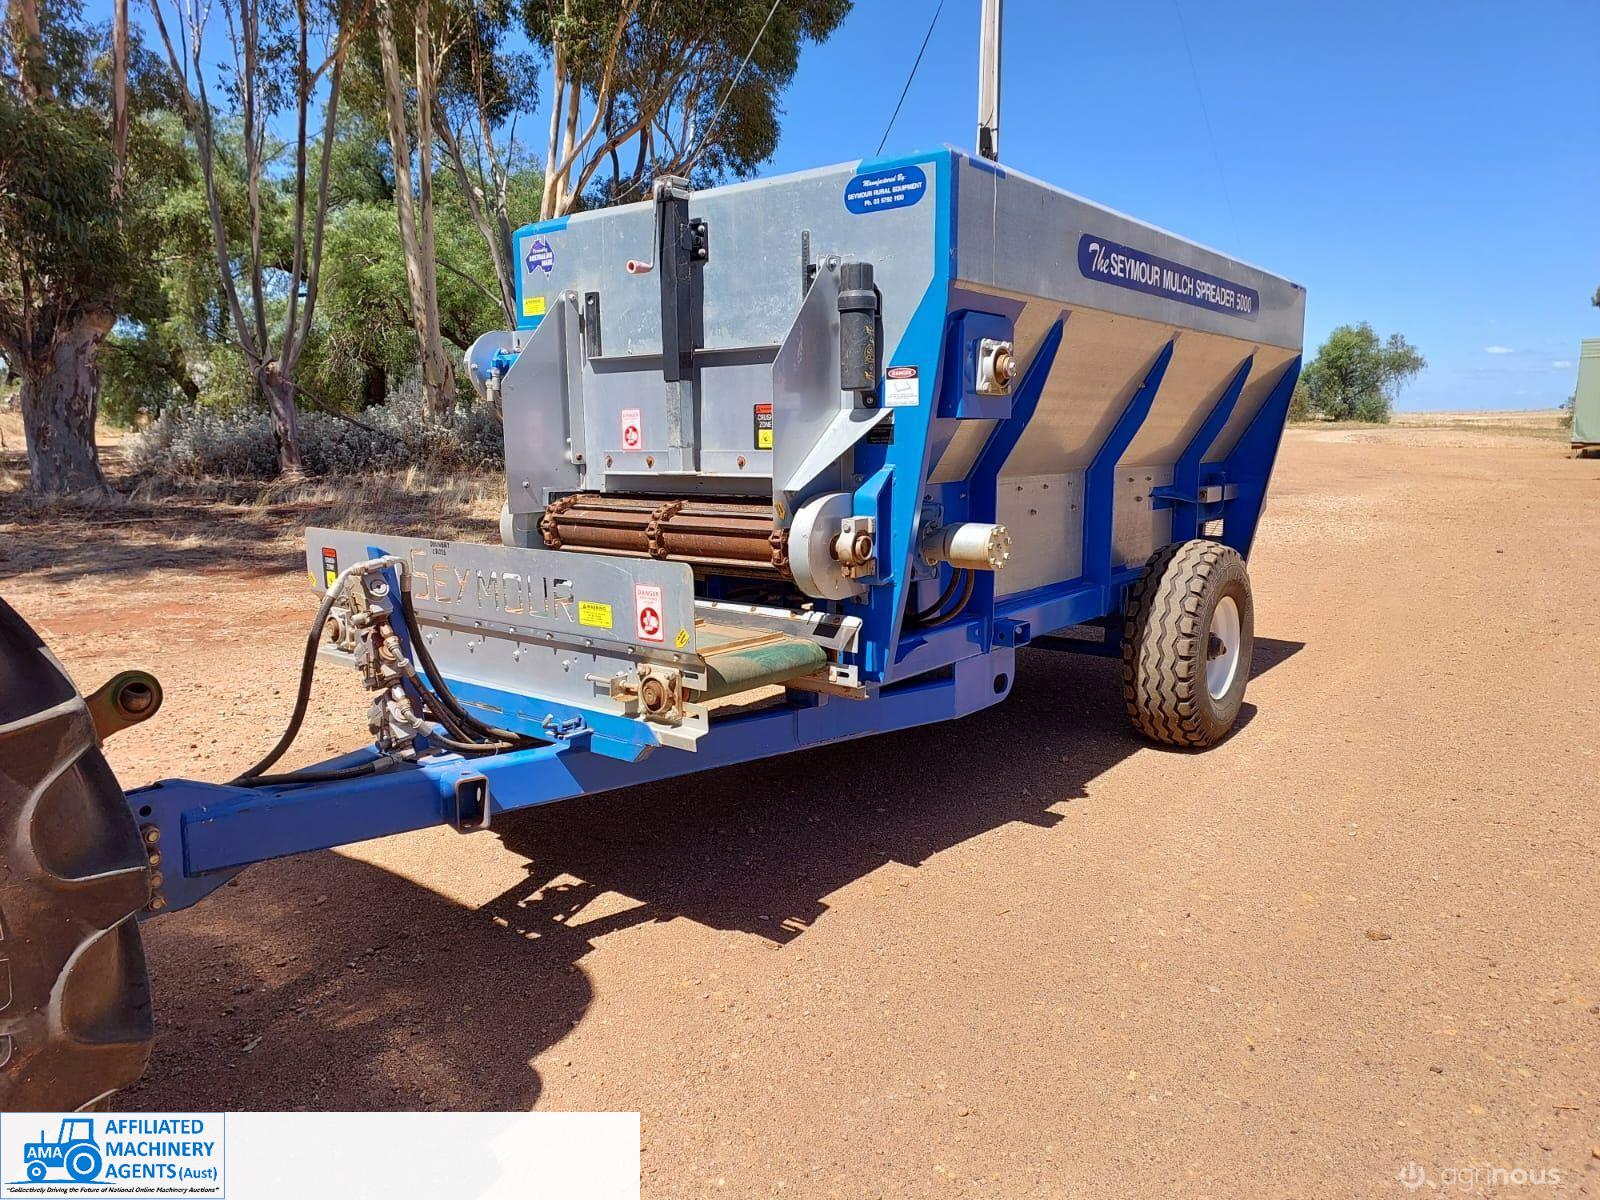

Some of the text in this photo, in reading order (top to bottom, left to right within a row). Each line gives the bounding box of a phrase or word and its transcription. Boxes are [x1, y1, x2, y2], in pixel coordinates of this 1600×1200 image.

[848, 182, 922, 200] SEYMOUR RURAL EQUIPMENT
[1088, 242, 1252, 313] The SEYMOUR MULCH SPREADER 5000
[410, 548, 575, 623] SEYMOUR
